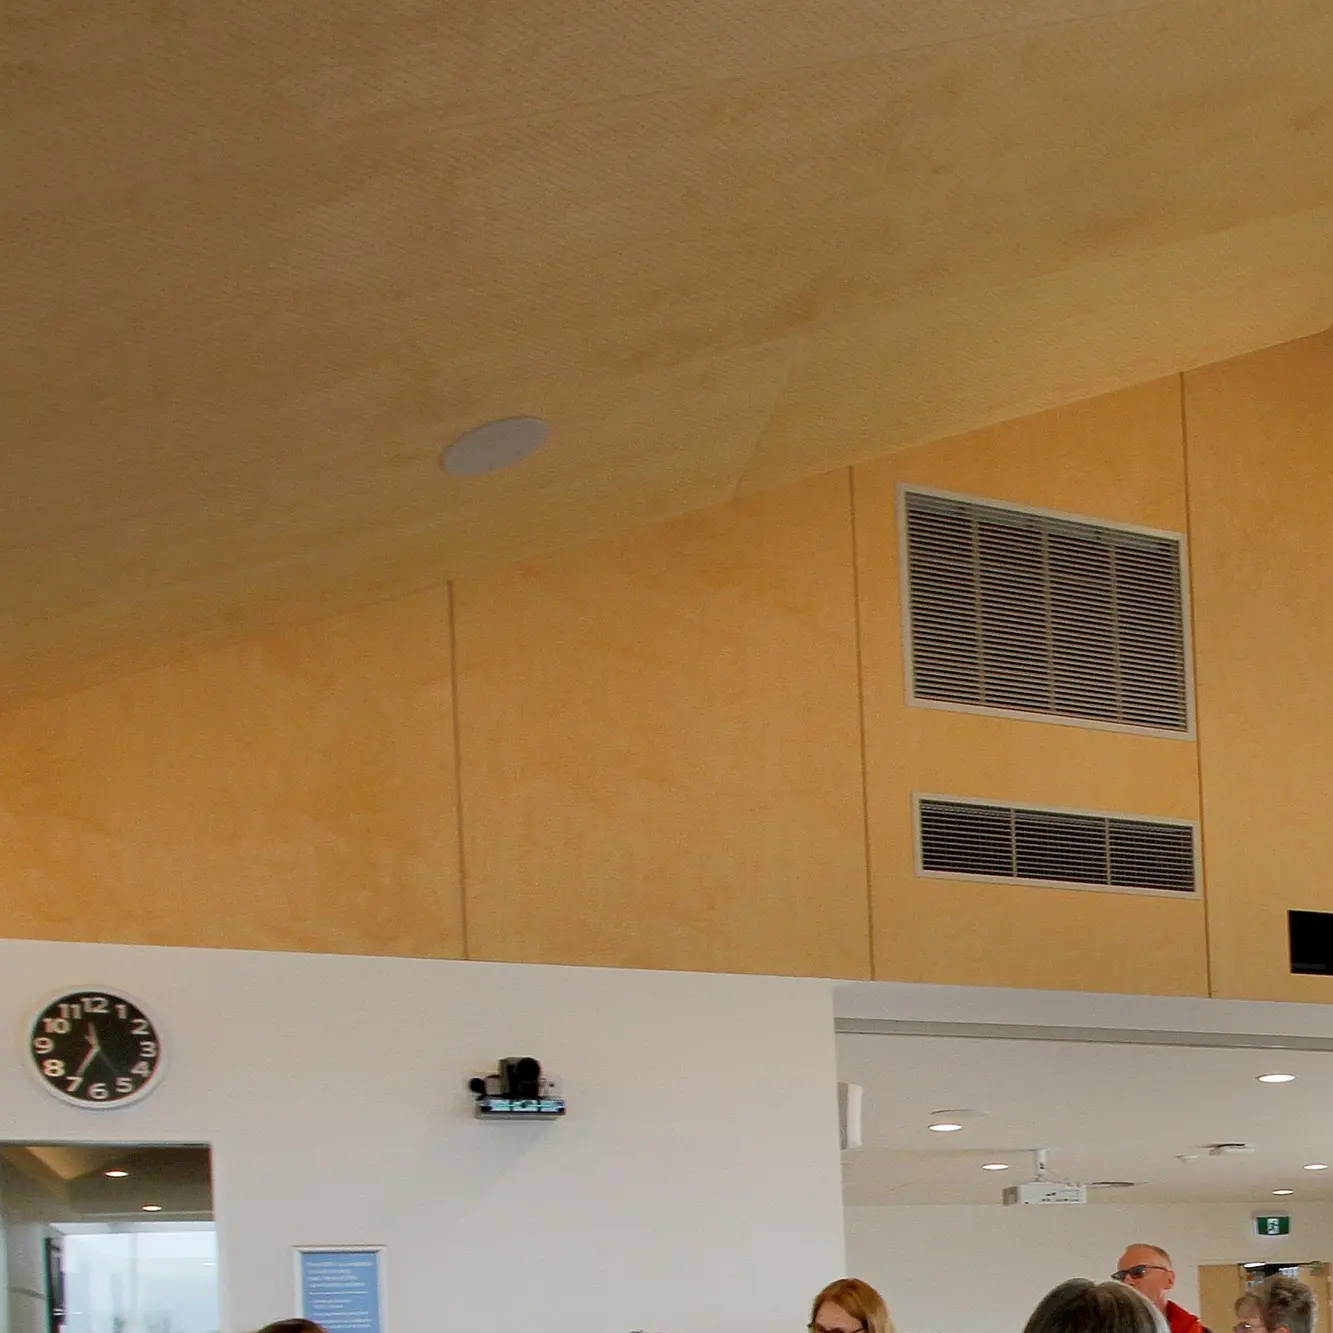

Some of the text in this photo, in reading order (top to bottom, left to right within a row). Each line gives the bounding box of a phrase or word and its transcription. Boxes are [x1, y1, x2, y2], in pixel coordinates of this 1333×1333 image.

[58, 1003, 82, 1019] 11
[81, 997, 109, 1013] 12
[116, 1004, 128, 1019] 1
[43, 1018, 70, 1034] 10
[132, 1019, 149, 1034] 2
[34, 1037, 54, 1054] 9
[140, 1041, 157, 1057] 3
[43, 1059, 65, 1077] 8
[130, 1061, 150, 1077] 4
[66, 1077, 84, 1092] 7
[89, 1083, 109, 1100] 6
[116, 1077, 133, 1093] 5
